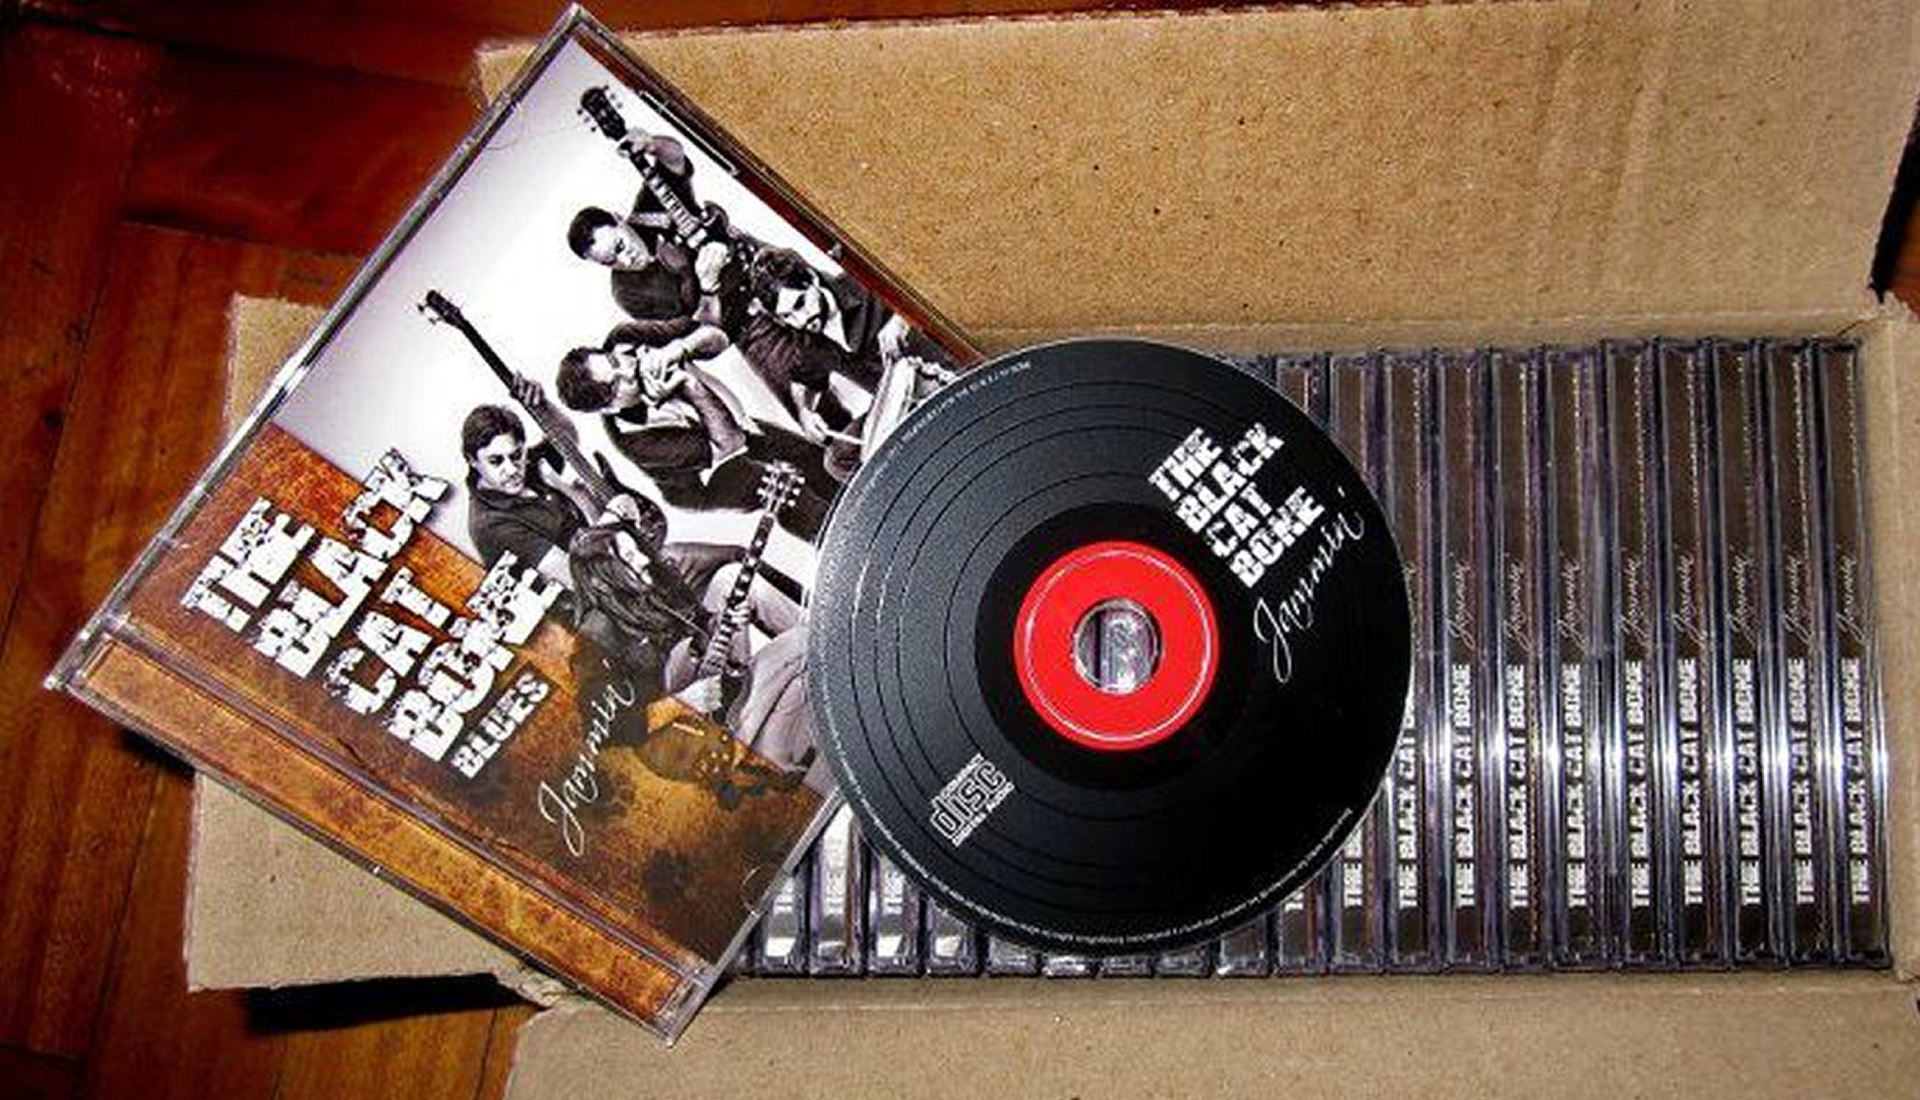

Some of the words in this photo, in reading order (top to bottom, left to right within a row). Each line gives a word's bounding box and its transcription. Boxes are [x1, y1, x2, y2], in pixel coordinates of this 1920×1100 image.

[1148, 427, 1223, 501] THE
[1175, 422, 1285, 534] BLACK
[1205, 481, 1273, 557] CAT
[1229, 486, 1326, 588] BONE
[181, 496, 316, 633] THE
[250, 447, 450, 679] BLACK
[322, 566, 451, 715] CAT
[383, 548, 566, 762] BONE
[1452, 664, 1471, 727] BONE
[1506, 664, 1524, 728] BONE
[1561, 663, 1580, 727] BONE
[1625, 661, 1644, 725] BONE
[1677, 658, 1697, 722] BONE
[1733, 658, 1753, 722] BONE
[1788, 658, 1806, 722] BONE
[1842, 658, 1860, 722] BONE
[451, 672, 551, 779] BLUES
[1397, 734, 1416, 777] CAT
[1453, 734, 1472, 777] CAT
[1508, 733, 1526, 777] CAT
[1564, 733, 1583, 777] CAT
[1627, 731, 1646, 775] CAT
[1680, 730, 1699, 773] CAT
[1737, 731, 1757, 774] CAT
[1790, 729, 1809, 773] CAT
[1845, 729, 1864, 773] CAT
[1397, 786, 1416, 859] BLACK
[1455, 785, 1473, 859] BLACK
[1509, 785, 1526, 859] BLACK
[1567, 784, 1585, 859] BLACK
[1630, 782, 1648, 857] BLACK
[1682, 781, 1700, 855] BLACK
[1739, 780, 1759, 855] BLACK
[1793, 780, 1812, 854] BLACK
[1848, 779, 1867, 854] BLACK
[1344, 863, 1363, 908] THE
[1399, 863, 1417, 909] THE
[1455, 863, 1474, 907] THE
[1510, 863, 1529, 908] THE
[1567, 863, 1586, 908] THE
[1631, 862, 1650, 907] THE
[1684, 860, 1702, 904] THE
[1740, 860, 1760, 905] THE
[1796, 860, 1814, 903] THE
[1850, 859, 1869, 904] THE
